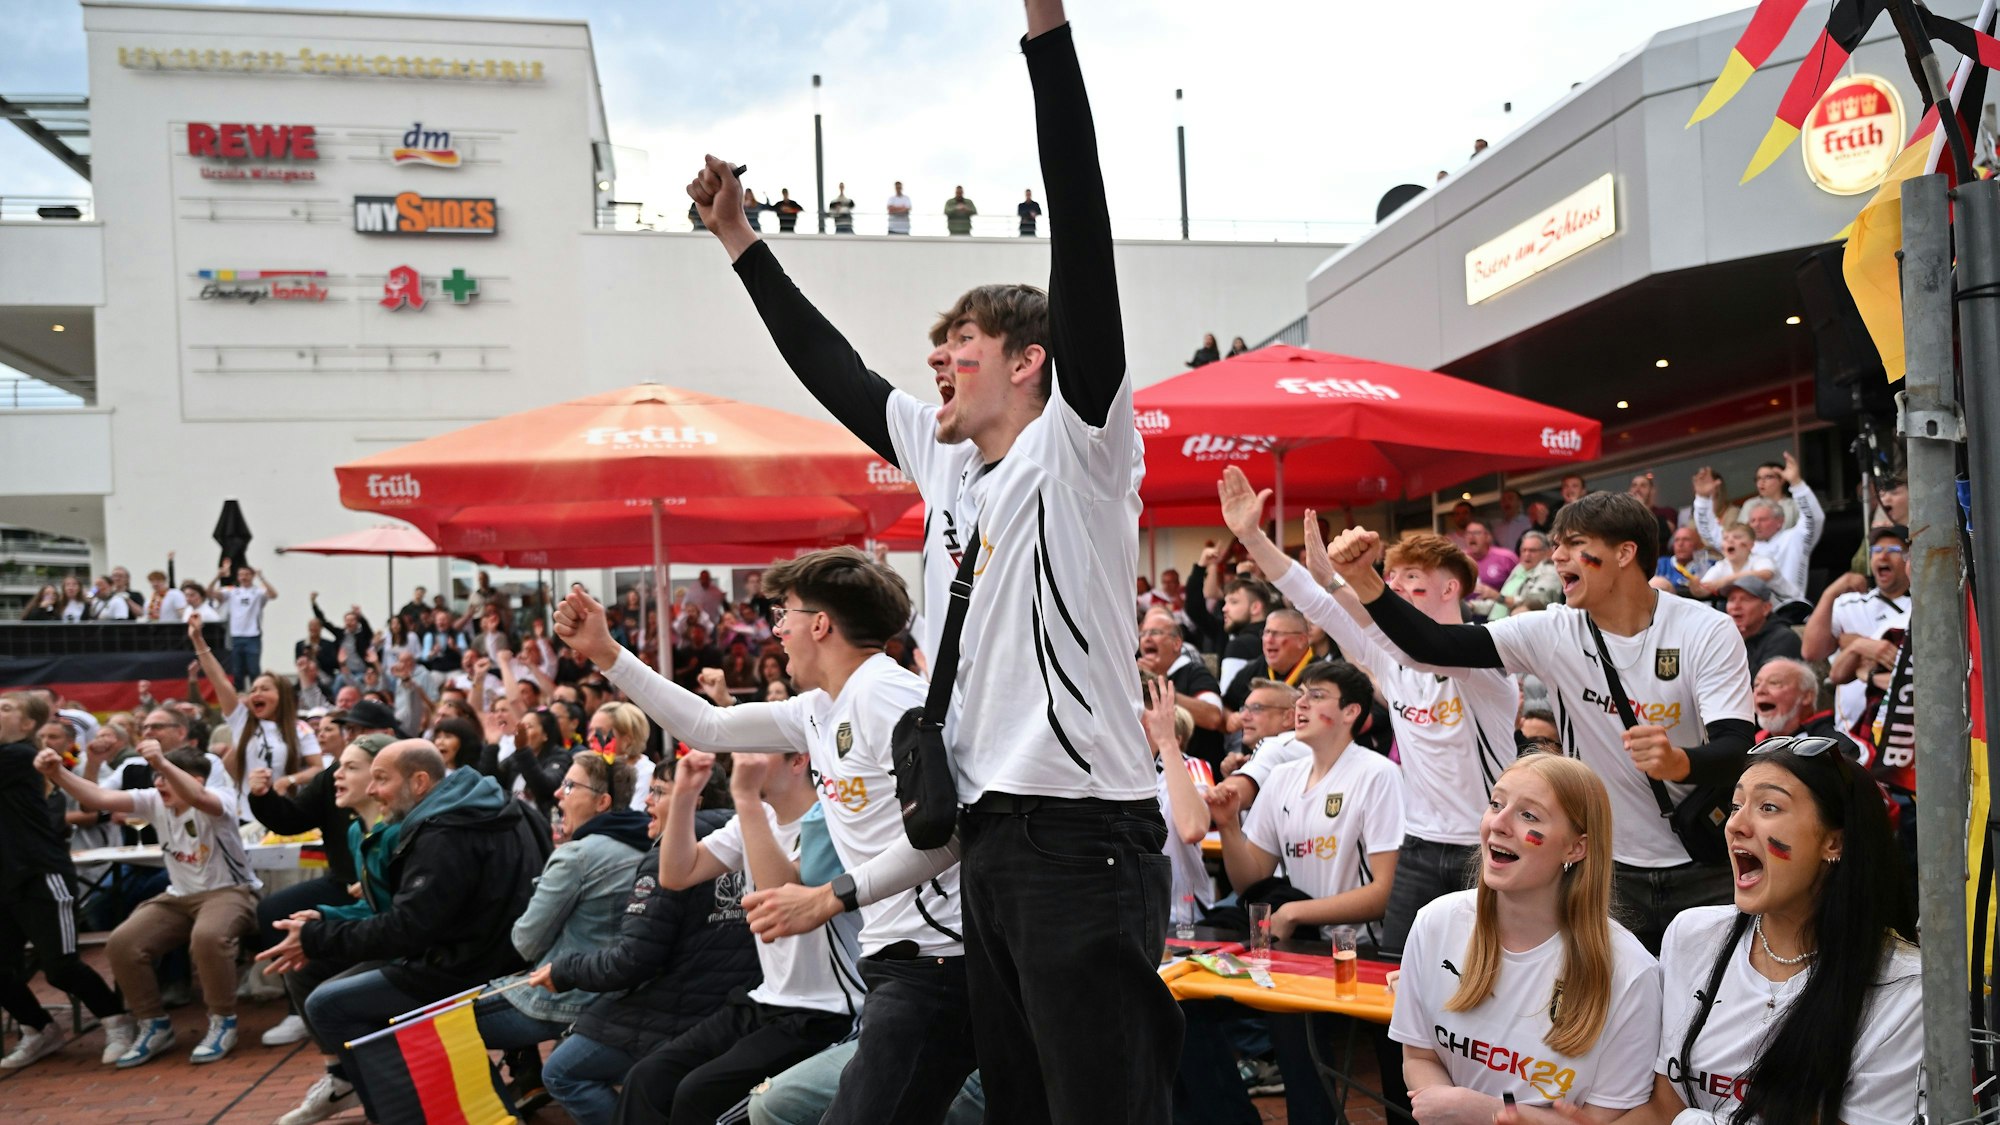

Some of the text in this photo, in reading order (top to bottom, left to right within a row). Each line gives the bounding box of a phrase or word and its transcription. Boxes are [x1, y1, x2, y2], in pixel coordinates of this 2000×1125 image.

[187, 122, 318, 159] REWE
[403, 122, 450, 150] dm
[1823, 122, 1884, 154] früh
[271, 281, 329, 304] family
[1275, 377, 1400, 400] früh
[1540, 427, 1582, 451] früh
[366, 473, 421, 499] früh
[1434, 1024, 1576, 1092] CHECK24
